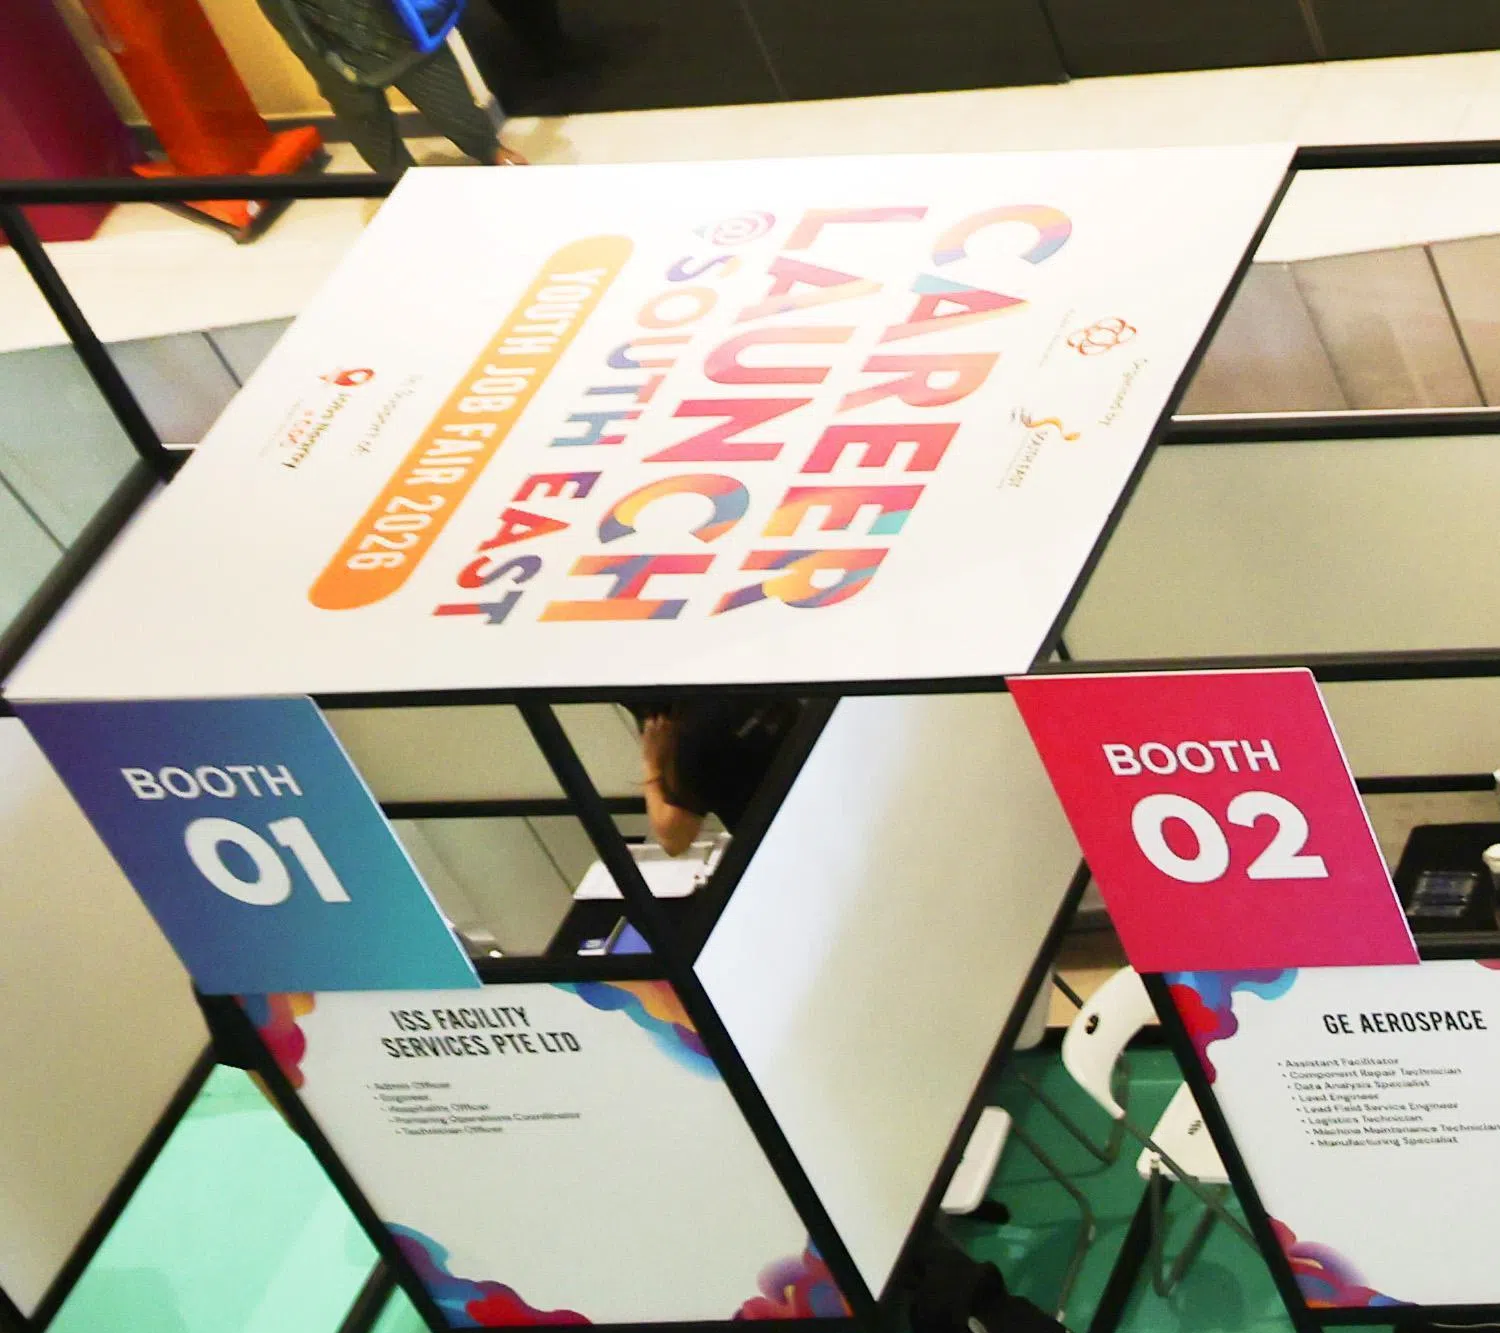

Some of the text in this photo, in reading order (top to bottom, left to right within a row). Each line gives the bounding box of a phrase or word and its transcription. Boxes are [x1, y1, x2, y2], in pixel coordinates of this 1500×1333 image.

[497, 268, 607, 355] YOUTH
[457, 366, 536, 414] JOB
[537, 206, 929, 622] LAUNCH
[708, 204, 1073, 616] CAREER
[405, 422, 498, 486] FAIR
[433, 254, 743, 624] SOUTH EAST
[346, 496, 446, 570] 2026
[121, 765, 304, 800] BOOTH
[1102, 739, 1280, 777] BOOTH
[184, 816, 352, 906] 01
[1131, 790, 1329, 884] 02
[382, 1032, 581, 1057] SERVICES PTE LTD
[390, 1006, 530, 1031] ISS FACILITY
[1323, 1010, 1487, 1034] GE AEROSPACE
